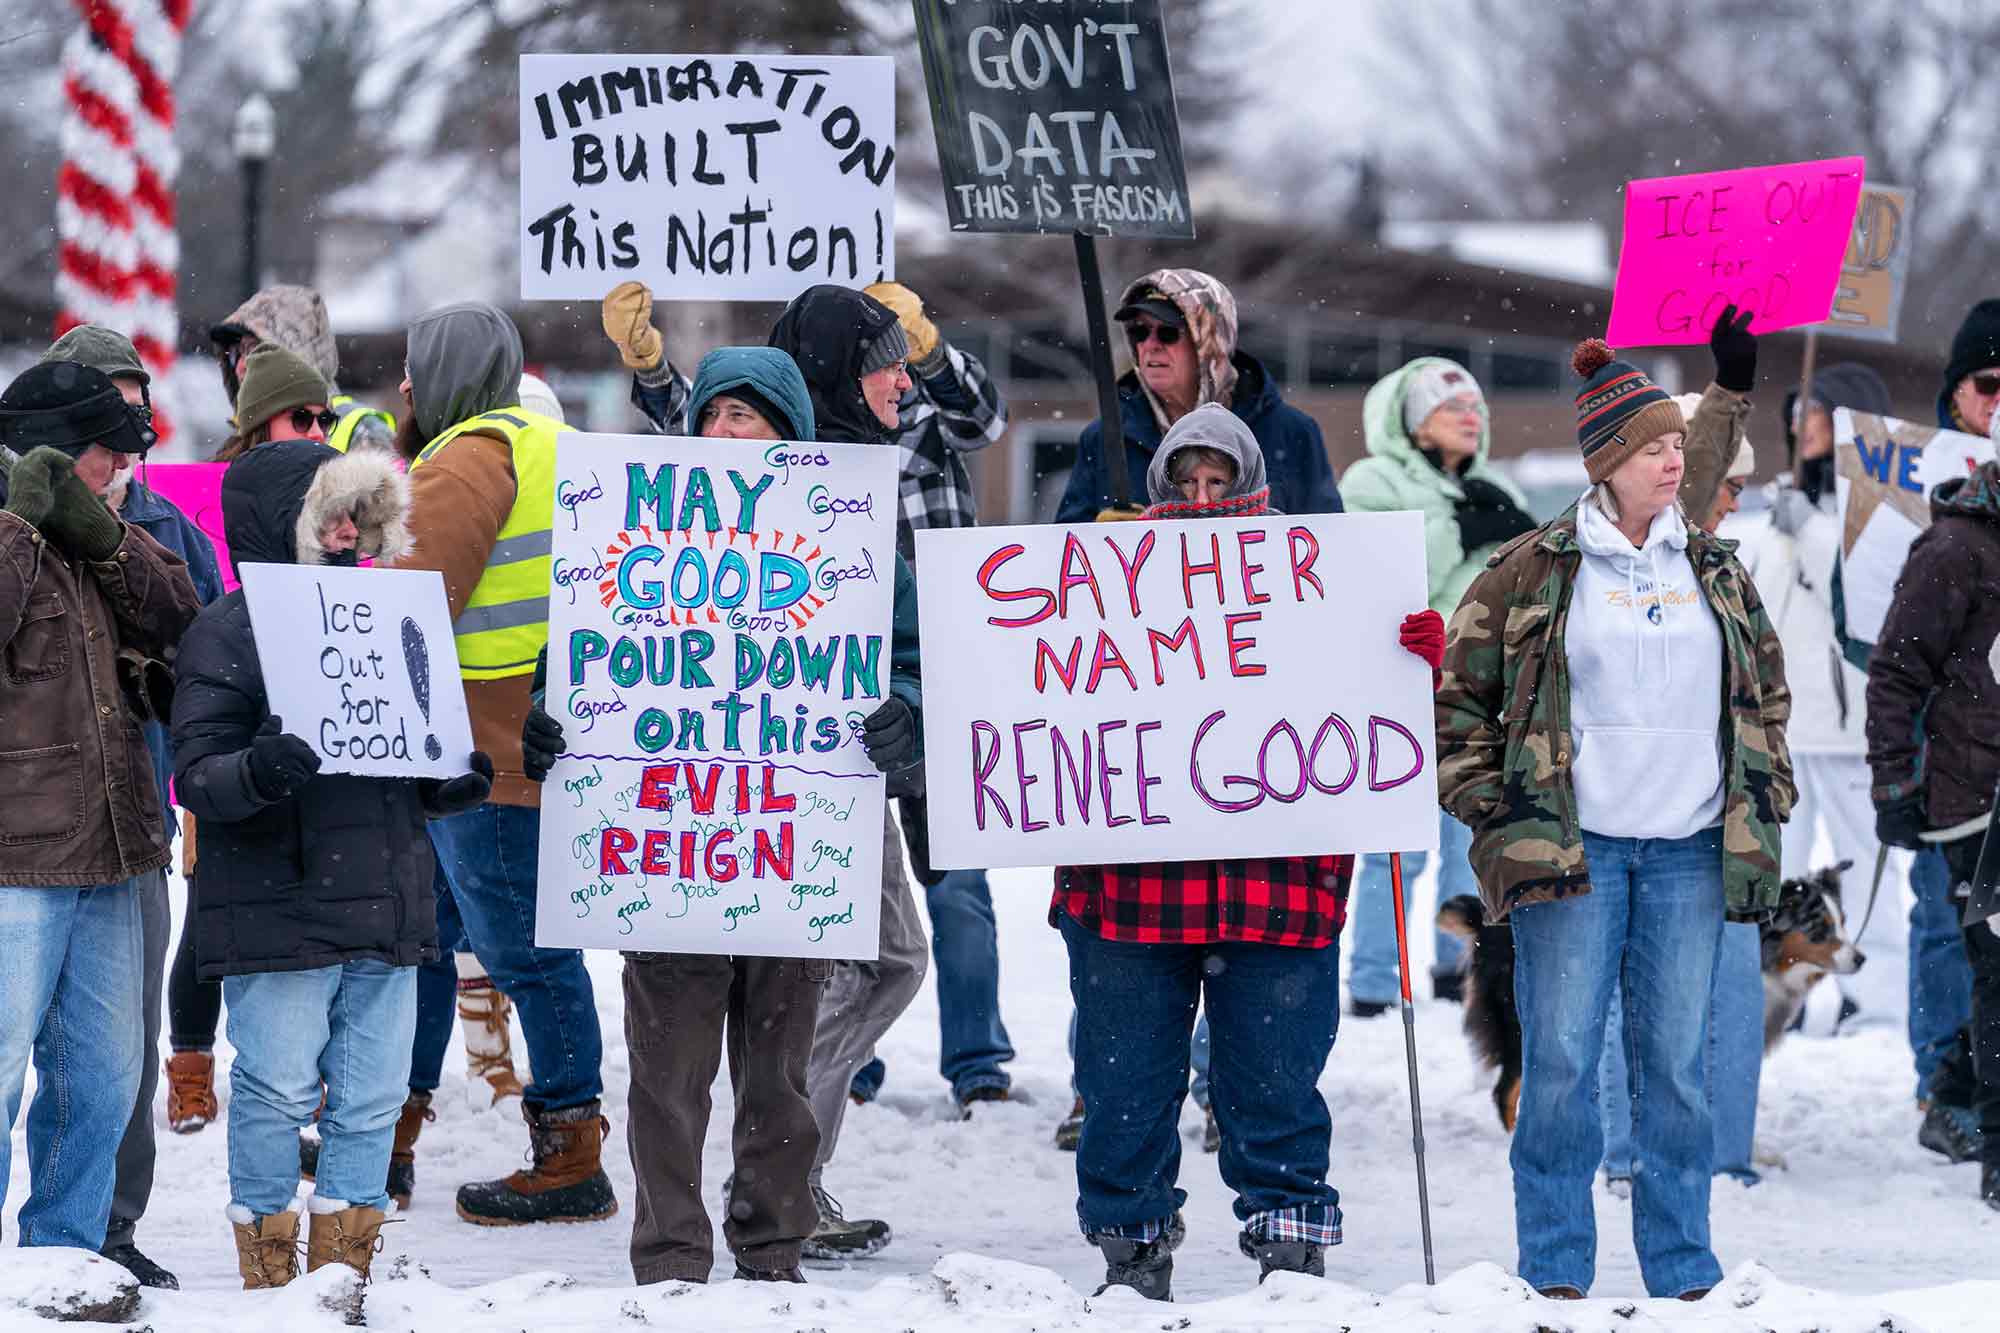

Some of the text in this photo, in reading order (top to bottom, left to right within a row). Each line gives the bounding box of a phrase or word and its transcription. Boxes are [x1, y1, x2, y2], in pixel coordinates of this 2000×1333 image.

[968, 17, 1140, 90] GOV'T
[534, 59, 895, 187] IMMIGRATION
[968, 111, 1156, 177] DATA
[572, 119, 782, 187] BUILT
[953, 183, 1185, 222] THIS IS FASCISM
[1656, 173, 1852, 240] ICE OUT
[527, 194, 884, 283] This Nation!
[1711, 242, 1753, 279] for
[1854, 434, 1925, 494] WE
[624, 463, 775, 534] MAY
[617, 544, 812, 612] GOOD
[977, 526, 1325, 628] SAY HER
[317, 581, 374, 635] Ice
[320, 646, 384, 680] Out
[570, 629, 883, 700] POUR DOWN
[1035, 612, 1267, 694] NAME
[341, 682, 389, 725] for
[634, 691, 842, 756] on this
[564, 764, 603, 808] good
[636, 762, 797, 815] EVIL
[972, 709, 1424, 832] RENEE GOOD
[799, 791, 856, 822] good
[600, 821, 795, 883] REIGN
[803, 839, 853, 873] good
[570, 874, 615, 919] good
[617, 891, 652, 936] good
[665, 877, 722, 919] good
[722, 893, 761, 932] good
[787, 876, 840, 911] good
[807, 901, 854, 943] good
